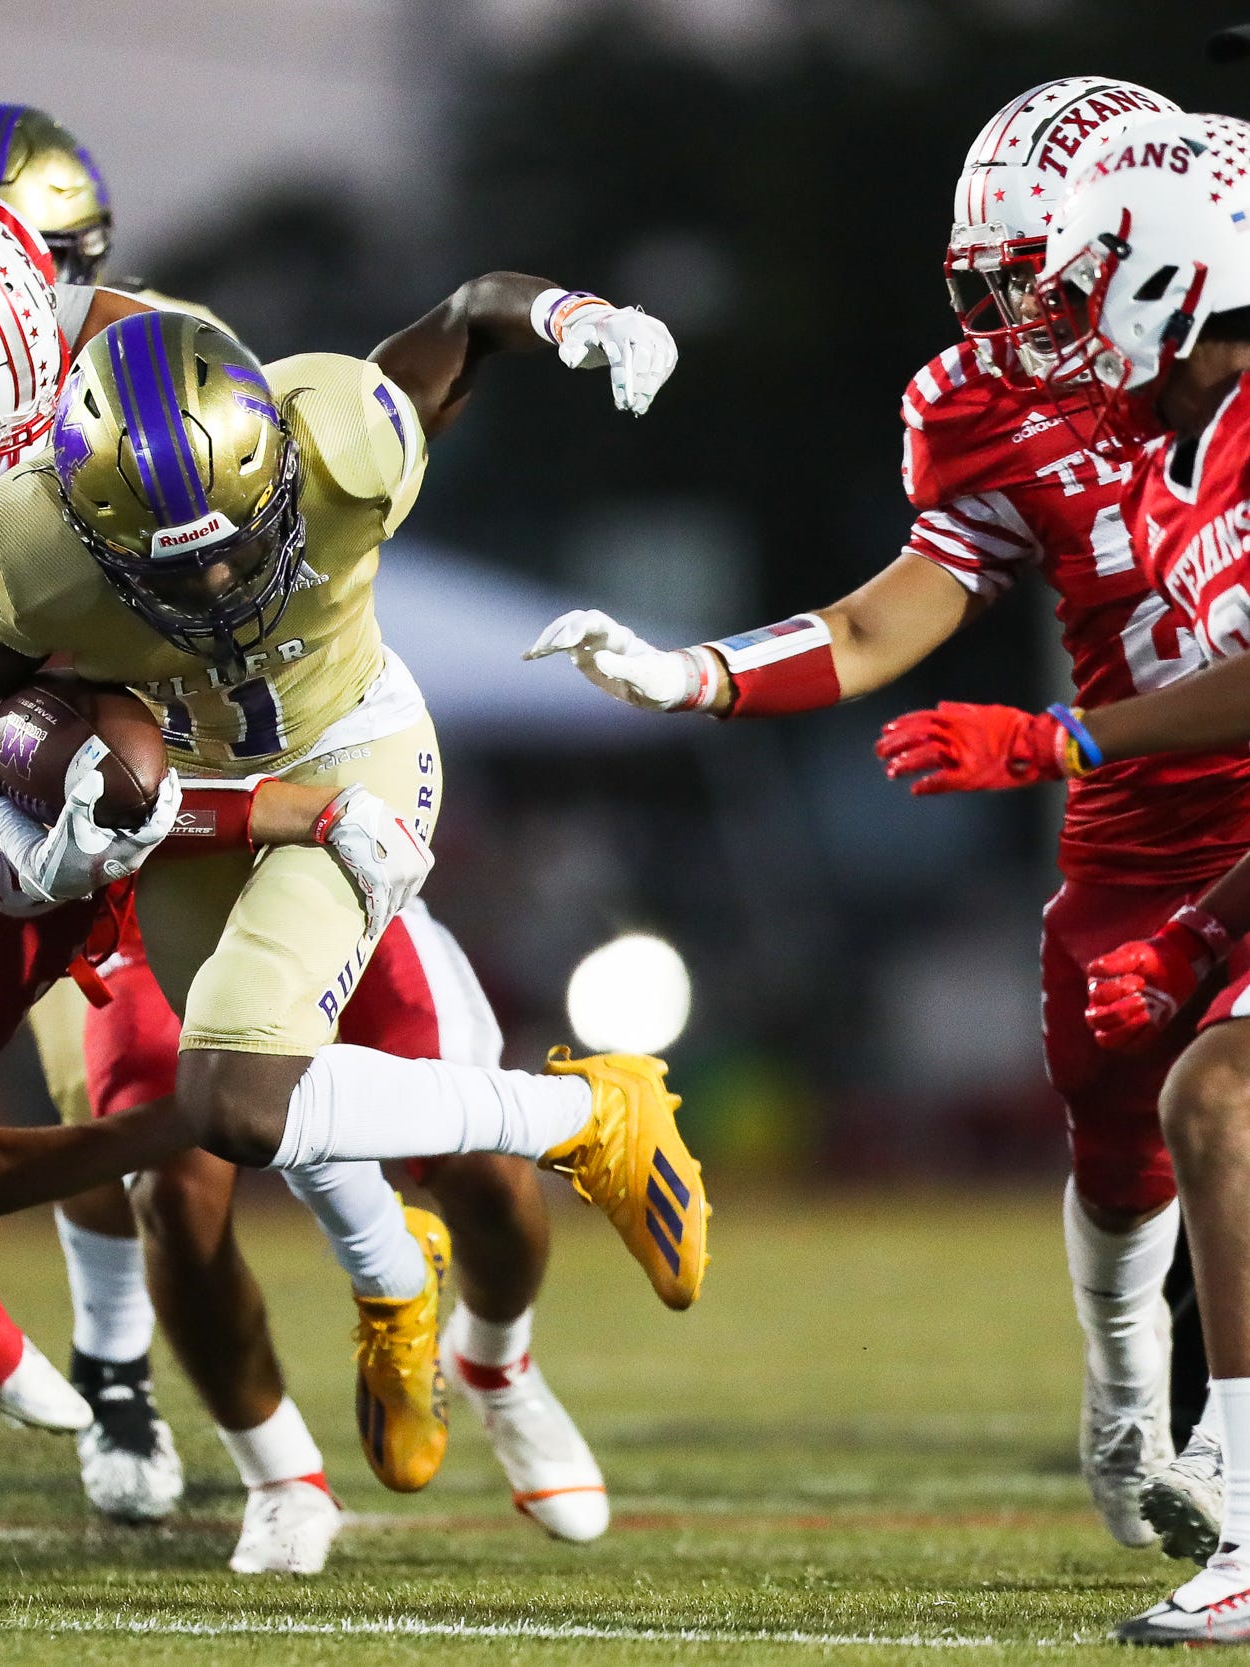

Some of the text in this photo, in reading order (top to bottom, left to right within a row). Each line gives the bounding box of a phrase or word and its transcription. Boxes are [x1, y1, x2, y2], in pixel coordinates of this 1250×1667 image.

[1037, 89, 1161, 179] TEXANS
[1075, 142, 1191, 188] XANS
[159, 518, 221, 548] Riddell
[147, 638, 306, 696] ILLER
[158, 674, 289, 761] 11
[317, 748, 372, 774] adidas
